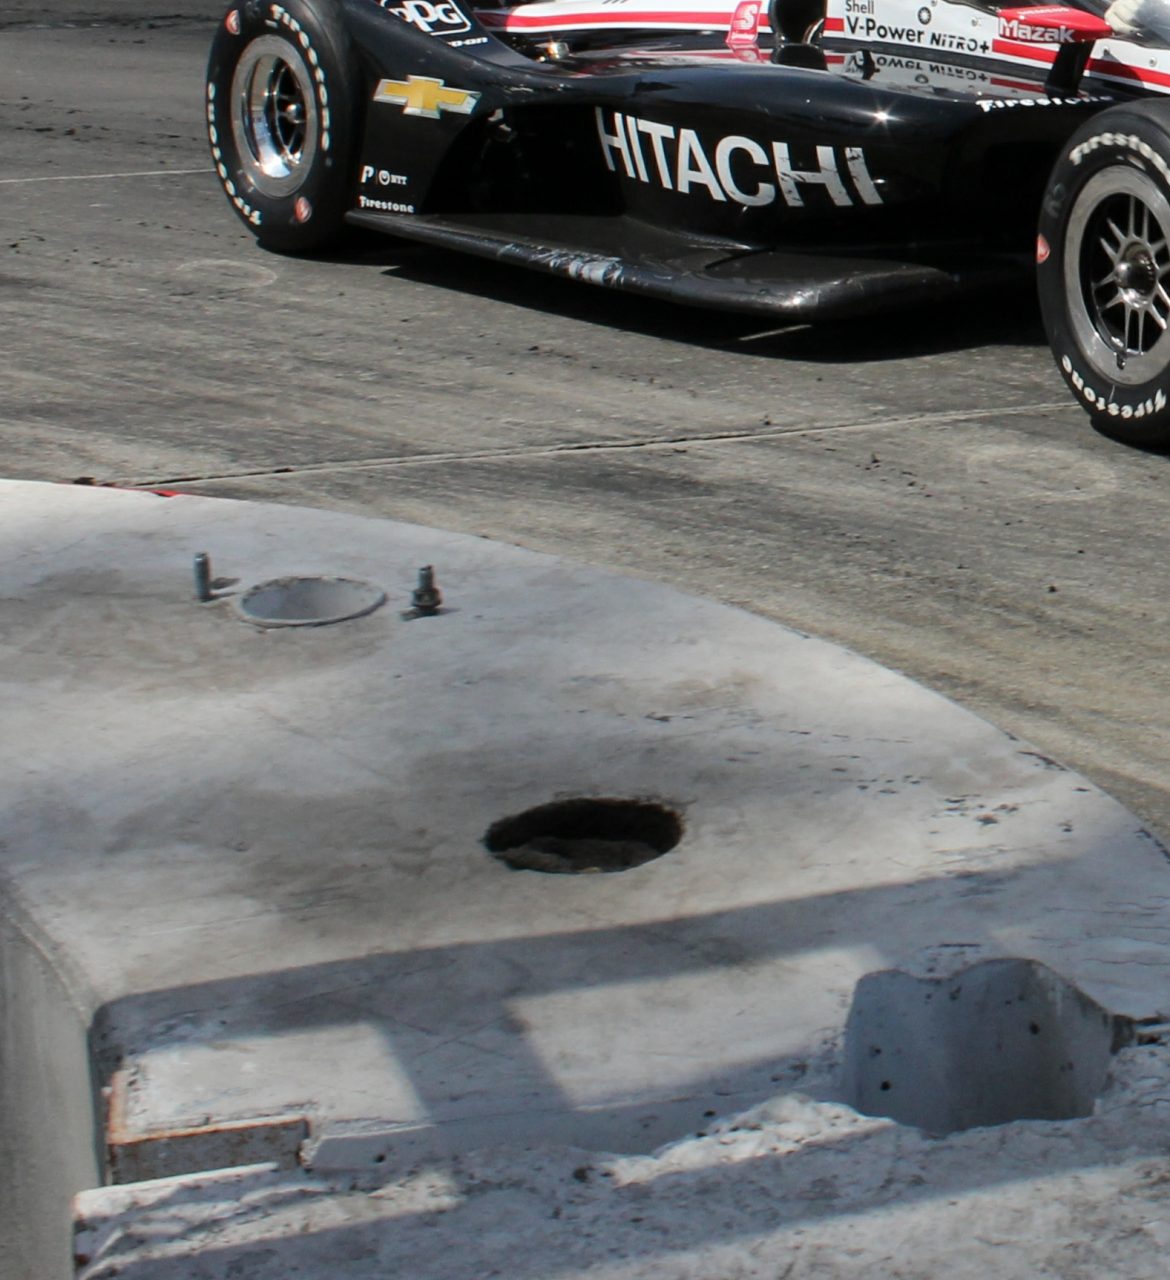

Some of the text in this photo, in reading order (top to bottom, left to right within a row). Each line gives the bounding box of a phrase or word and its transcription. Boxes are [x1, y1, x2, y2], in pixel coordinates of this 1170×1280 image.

[845, 17, 925, 43] V-Power
[999, 17, 1076, 43] Mazak
[595, 106, 884, 207] HITACHI
[359, 195, 415, 214] Firestone
[1061, 354, 1167, 419] Firestone
